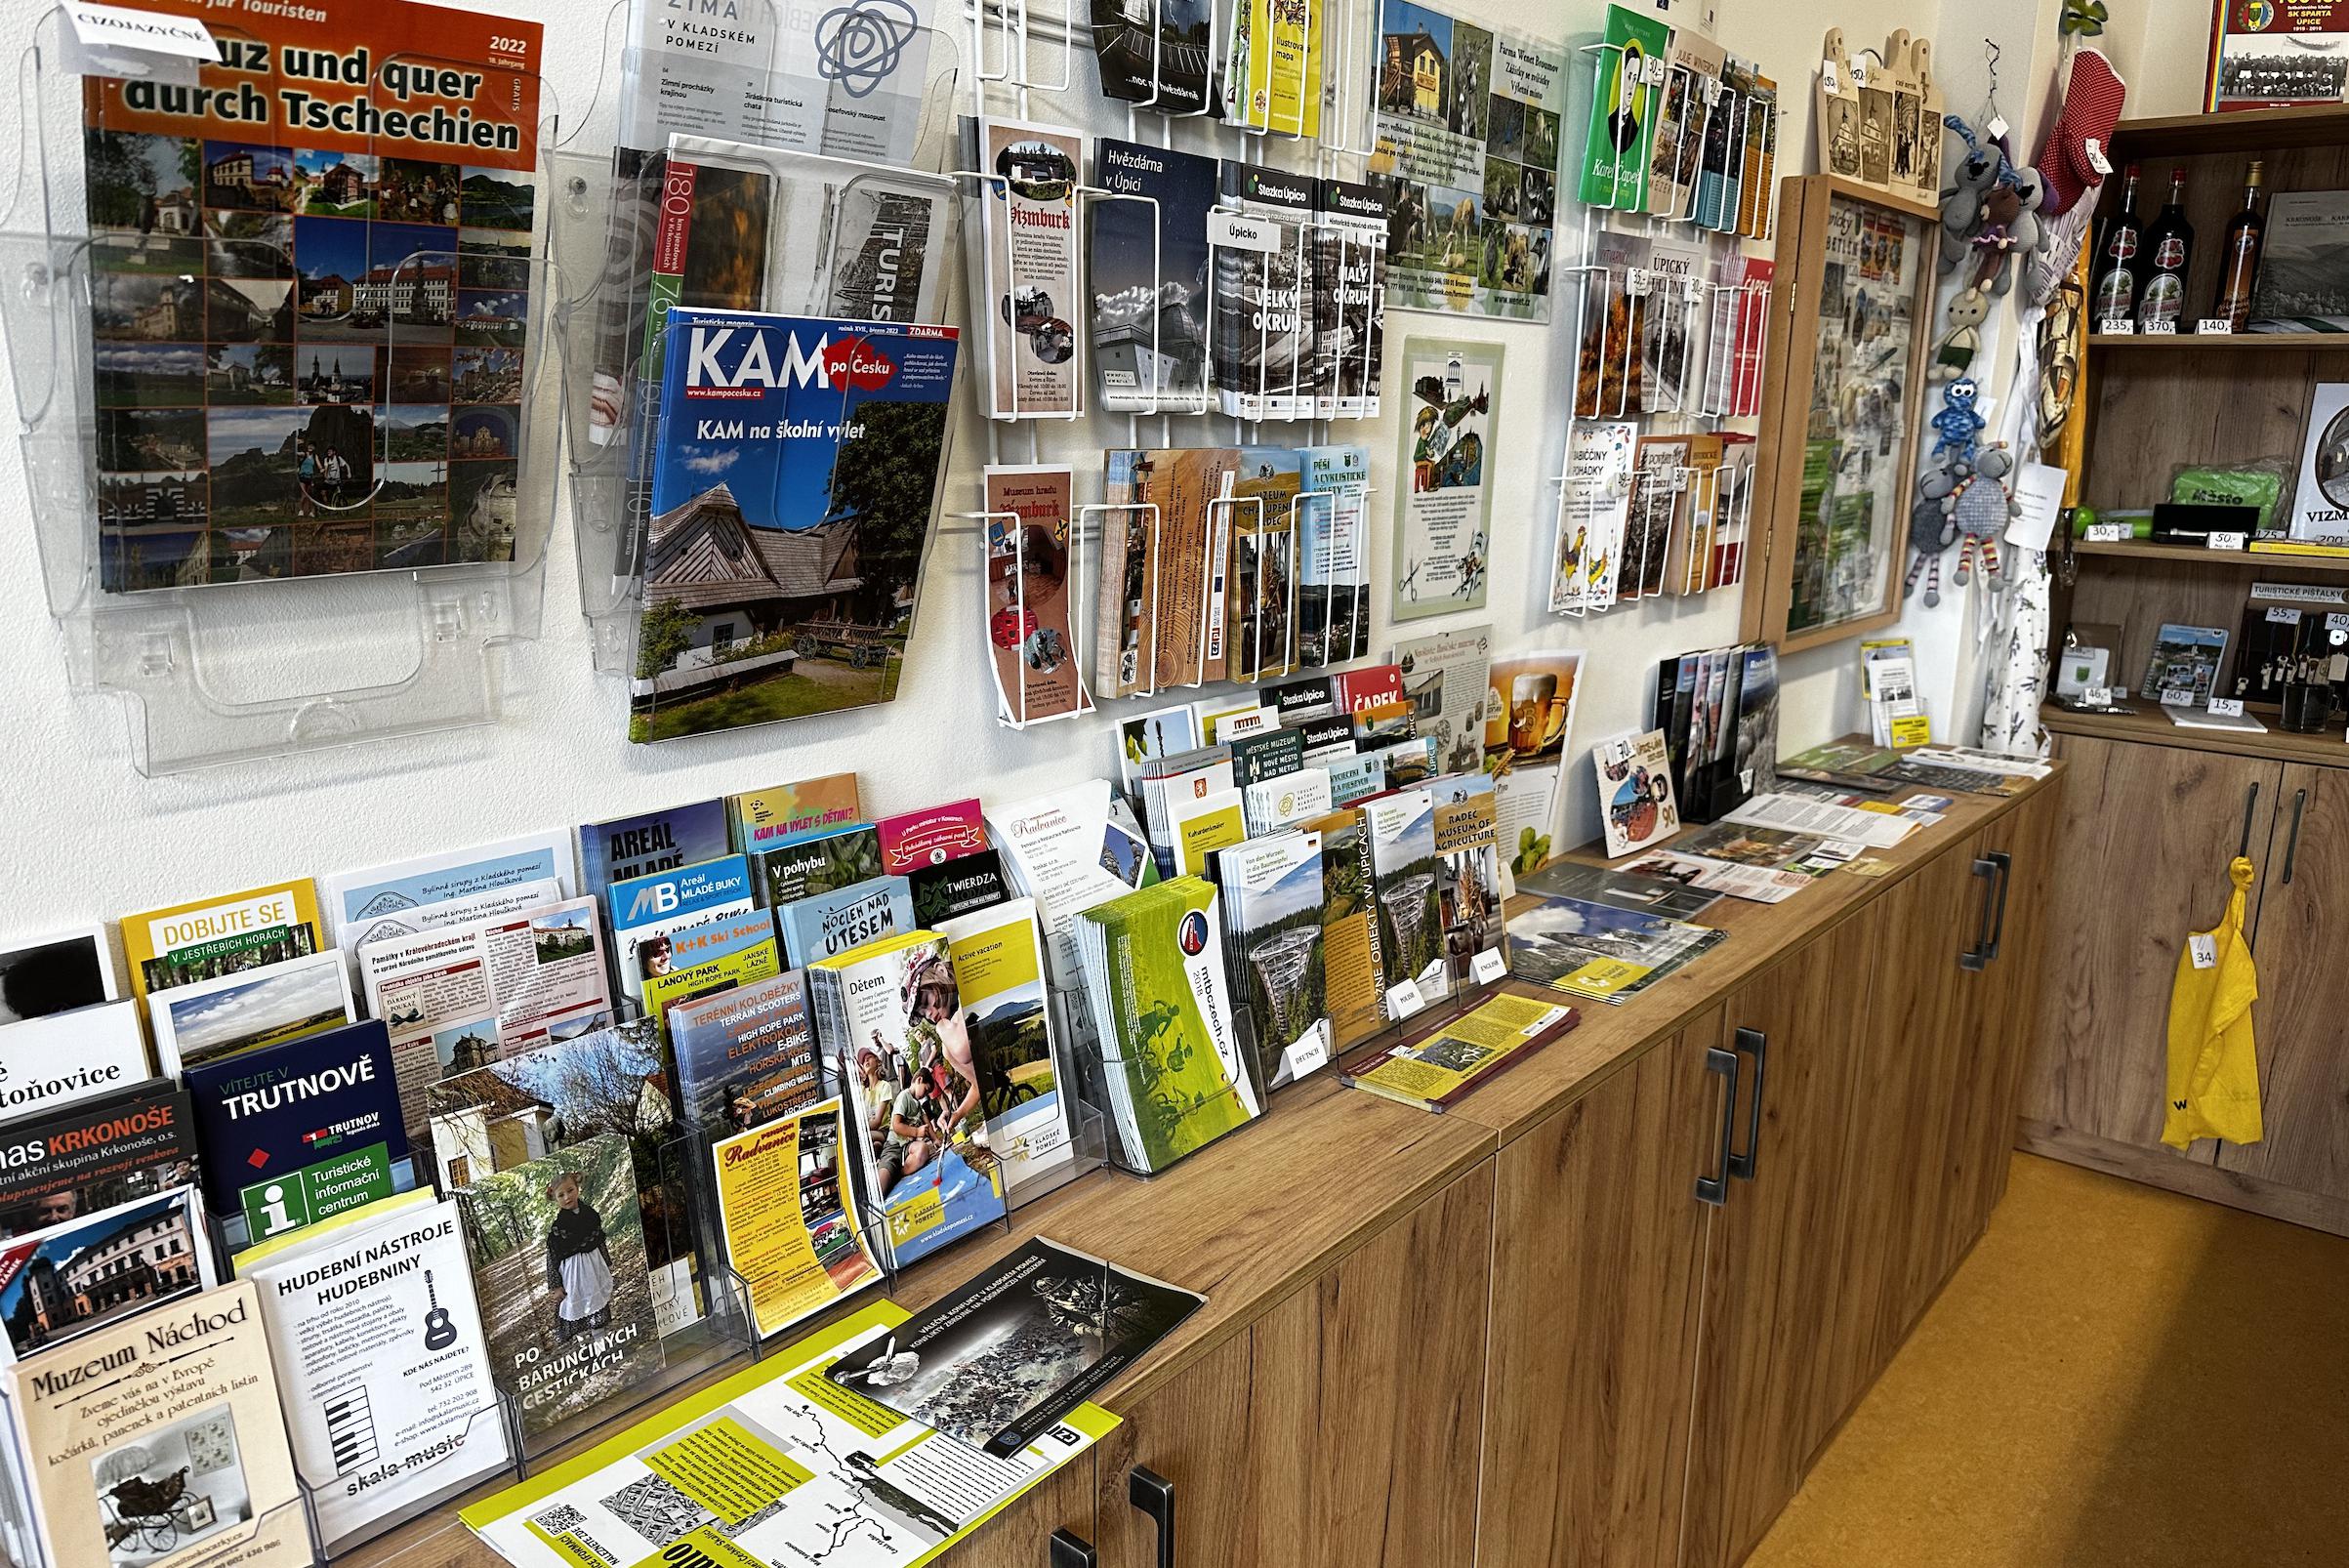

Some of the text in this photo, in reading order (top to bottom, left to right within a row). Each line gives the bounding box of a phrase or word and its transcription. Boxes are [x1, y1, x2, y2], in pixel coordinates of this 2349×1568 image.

[243, 0, 327, 22] Touristen
[668, 20, 756, 44] V KLADSKÉM
[490, 35, 527, 54] 2022
[666, 35, 719, 53] POMEZÍ
[1276, 49, 1294, 62] mapa
[283, 46, 368, 85] und
[383, 62, 482, 101] quer
[512, 78, 520, 112] GRATIS
[660, 88, 686, 100] krajinou
[661, 78, 716, 95] Zimní procházky
[744, 102, 762, 111] chata
[774, 96, 803, 107] turistická
[124, 80, 519, 150] durch Tschechien
[858, 111, 886, 122] masopust
[1108, 149, 1163, 173] Hvězdárna
[1592, 158, 1614, 179] Karel
[664, 166, 693, 216] 180
[1105, 171, 1141, 192] v Úpici
[1257, 183, 1306, 203] Stezka Úpice
[1339, 196, 1383, 213] Stezka Úpice
[1229, 223, 1257, 240] Úpicko
[1653, 252, 1691, 275] ÚPICKÝ
[692, 317, 724, 327] Turistický
[909, 327, 943, 338] ZDARMA
[2105, 320, 2133, 333] 235,-
[2148, 321, 2175, 333] 370,-
[2202, 320, 2232, 333] 140,-
[686, 327, 829, 390] KAM
[830, 361, 847, 376] po
[852, 354, 889, 375] Česku
[687, 389, 761, 398] www.kampocesku.cz
[696, 419, 866, 442] KAM na školní výlet
[2192, 489, 2244, 506] Město
[2092, 525, 2117, 537] 30,-
[2254, 586, 2342, 597] TURISTICKÉ PÍŠŤALKY
[1283, 688, 1325, 706] Stezka Úpice
[2213, 699, 2238, 711] 15,-
[1246, 735, 1297, 756] MĚSTSKÉ MUZEUM
[1307, 726, 1349, 745] Stezka Úpice
[1263, 753, 1298, 768] NOVÉ MĚSTO
[1263, 769, 1277, 778] NAD
[789, 817, 812, 835] VÝLET
[1438, 819, 1491, 839] MUSEUM OF
[610, 818, 677, 861] AREÁL
[1357, 816, 1373, 879] ÚPICACH
[1434, 830, 1496, 852] AGRICULTURE
[772, 853, 826, 879] V pohybu
[1255, 853, 1264, 863] den
[480, 869, 515, 882] Kladského
[680, 874, 706, 887] Areál
[946, 872, 998, 894] TWIERDZA
[459, 883, 487, 895] Martina
[681, 876, 742, 899] MLADÉ BUKY
[1364, 885, 1373, 896] W
[163, 901, 286, 946] DOBIJTE SE
[822, 893, 889, 932] NOCLEH NAD
[733, 919, 771, 938] School
[825, 909, 893, 954] ÚTESEM
[1365, 904, 1382, 964] OBIEKTY
[171, 928, 286, 963] V JESTŘEBÍCH HORÁCH
[958, 942, 1003, 963] Active vacation
[372, 952, 398, 965] Památky
[1480, 959, 1500, 972] ENGLISH
[658, 964, 721, 989] LANOVÝ PARK
[849, 975, 886, 995] Dětem
[1192, 970, 1204, 997] 2018
[693, 981, 801, 1027] TERÉNNÍ KOLOBĚŽKY
[1373, 969, 1389, 1020] WAŻNE
[1399, 991, 1415, 1005] POLISH
[721, 991, 802, 1028] TERRAIN SCOOTERS
[1201, 965, 1230, 1059] mtbczech.cz
[738, 1011, 805, 1044] HIGH ROPE PARK
[727, 1023, 806, 1060] ELEKTROKOLA
[777, 1030, 809, 1052] E-BIKE
[791, 1052, 811, 1068] MTB
[1296, 1048, 1319, 1065] DEUTSCH
[219, 1067, 275, 1095] VÍTEJTE
[222, 1053, 375, 1121] TRUTNOVĚ
[795, 1072, 815, 1086] WALL
[48, 1104, 174, 1157] KRKONOŠE
[328, 1112, 380, 1135] TRUTNOV
[18, 1137, 156, 1181] akční skupina Krkonoše,
[311, 1156, 372, 1184] Turistické
[315, 1169, 380, 1201] informační
[318, 1191, 369, 1216] centrum
[277, 1219, 454, 1297] HUDEBNÍ NÁSTROJE
[316, 1254, 422, 1305] HUDEBNINY
[32, 1346, 139, 1402] Muzeum
[145, 1297, 248, 1355] Náchod
[514, 1346, 540, 1370] PO
[403, 1346, 470, 1378] KDE NAJDETE?
[80, 1357, 216, 1419] Zveme vás na Evropě
[162, 1378, 207, 1402] výstavu
[103, 1414, 153, 1448] panenek
[347, 1461, 399, 1498] skala
